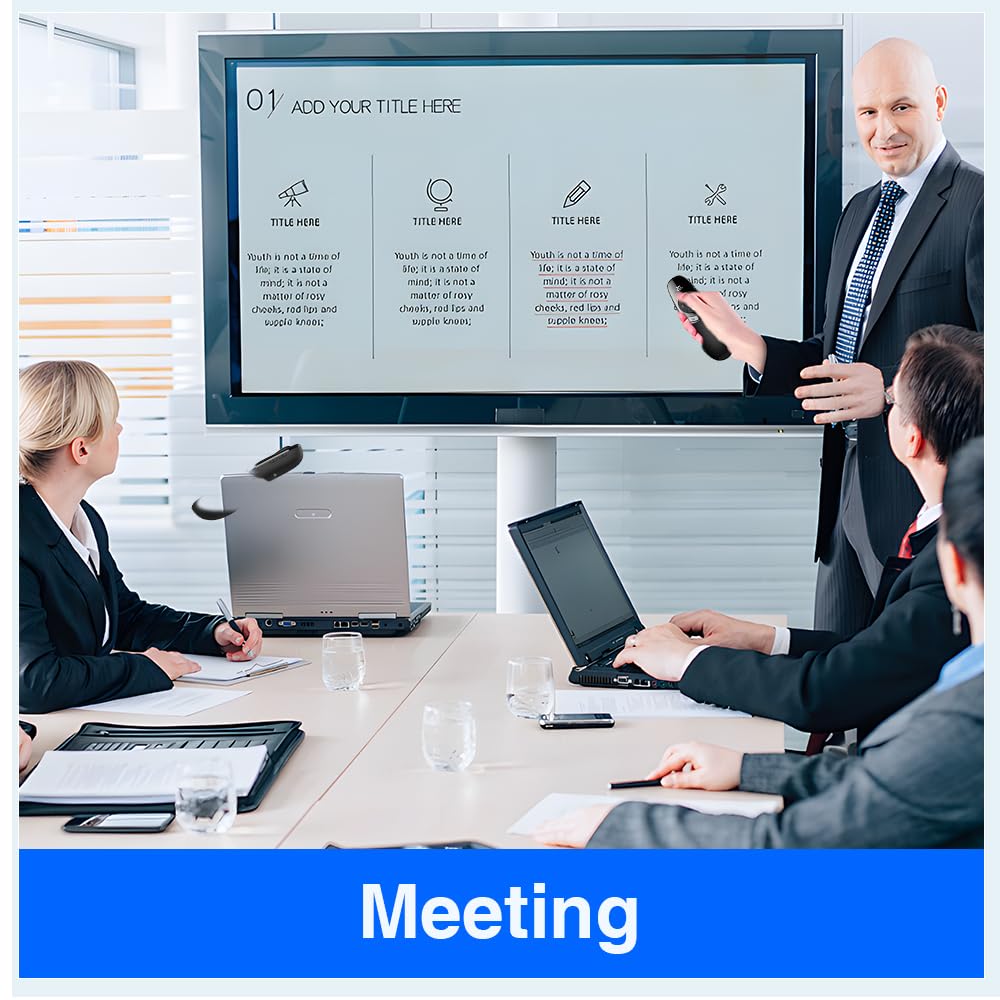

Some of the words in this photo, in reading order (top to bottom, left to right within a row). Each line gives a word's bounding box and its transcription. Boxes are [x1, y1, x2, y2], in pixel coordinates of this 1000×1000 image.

[291, 100, 325, 114] ADD
[329, 100, 371, 114] YOUR
[376, 99, 417, 113] TITLE
[423, 99, 461, 113] HERE
[270, 217, 294, 228] TITLE
[296, 217, 320, 228] HERE
[412, 216, 437, 227] TITLE
[438, 216, 462, 226] HERE
[551, 216, 576, 226] TITLE
[577, 215, 601, 226] HERE
[687, 215, 712, 225] TITLE
[713, 214, 738, 225] HERE
[246, 252, 272, 262] Youth
[283, 253, 299, 262] not
[394, 251, 420, 261] Youth
[430, 252, 447, 261] not
[530, 251, 555, 259] Youth
[668, 249, 694, 259] Youth
[705, 250, 721, 259] not
[304, 279, 321, 288] not
[452, 278, 468, 287] not
[727, 276, 743, 285] not
[320, 305, 338, 314] and
[467, 303, 485, 313] and
[604, 303, 620, 312] and
[742, 302, 760, 311] and
